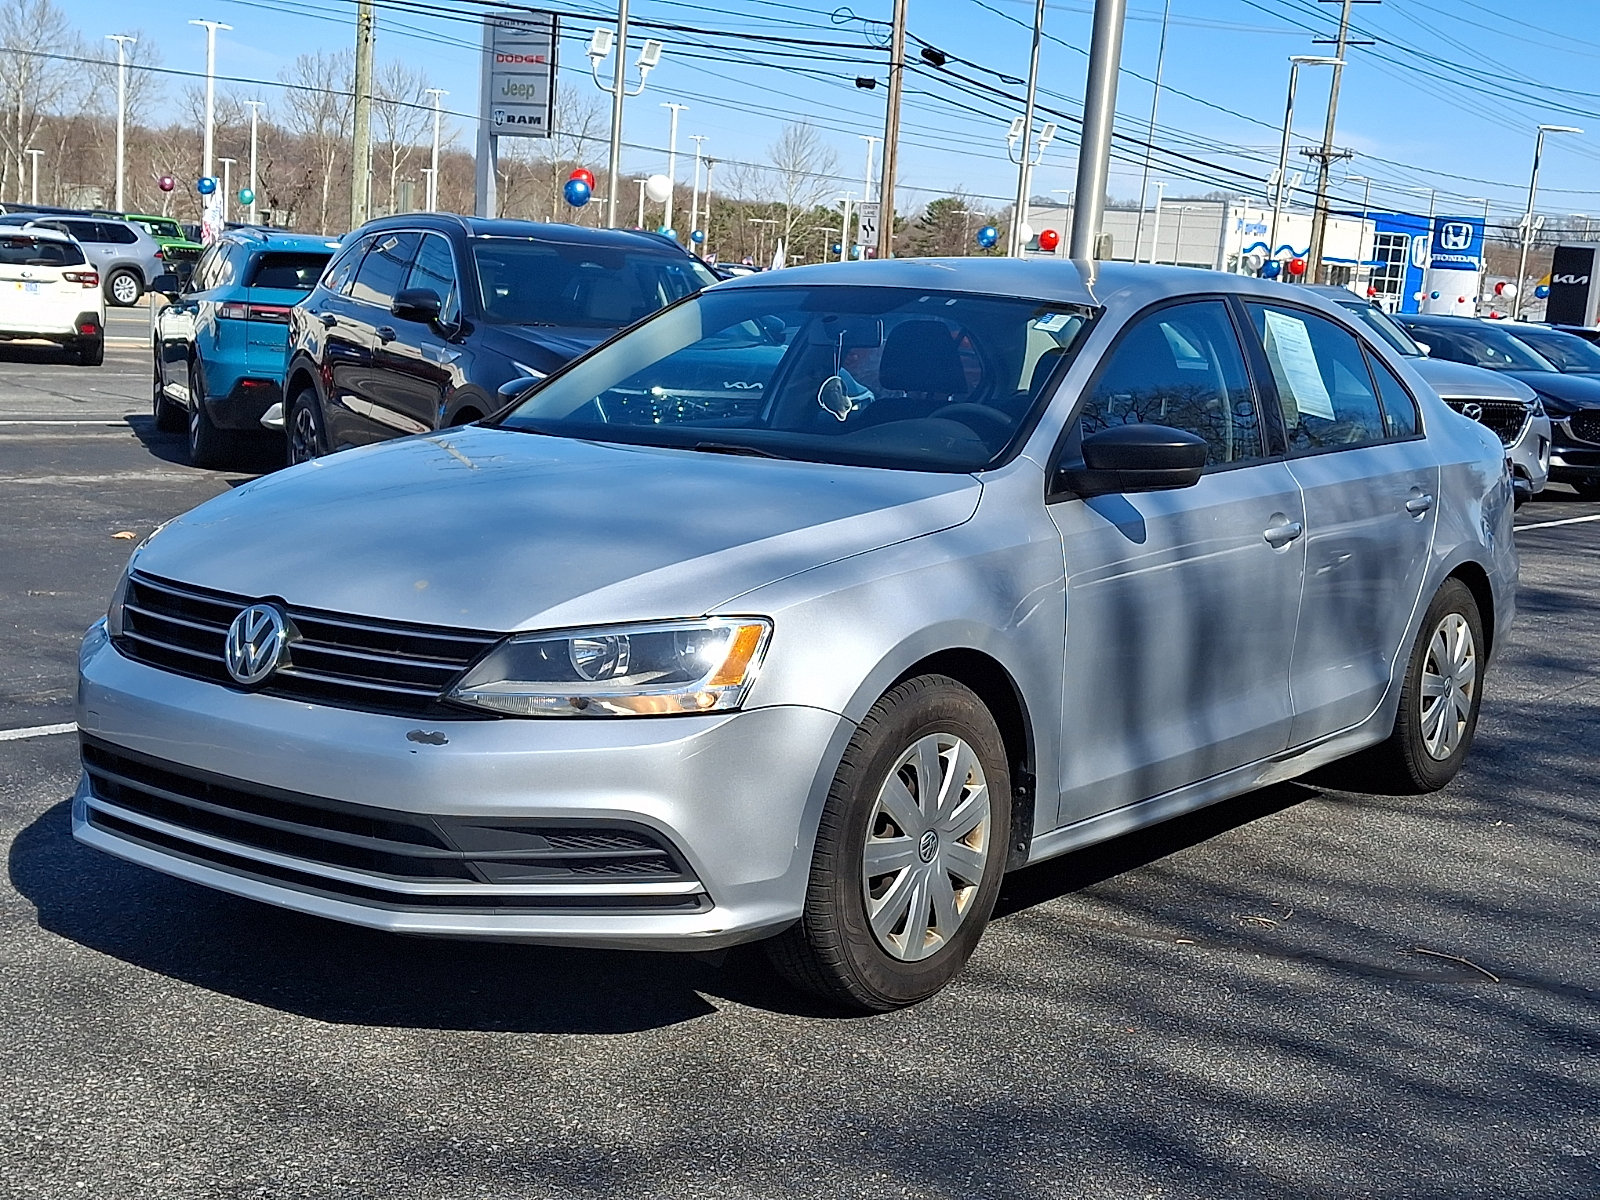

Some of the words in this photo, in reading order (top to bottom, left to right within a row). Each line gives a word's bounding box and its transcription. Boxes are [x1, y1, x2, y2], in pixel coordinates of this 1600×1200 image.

[497, 54, 545, 63] DODGE
[502, 79, 535, 98] Jeep
[507, 115, 541, 124] RAM
